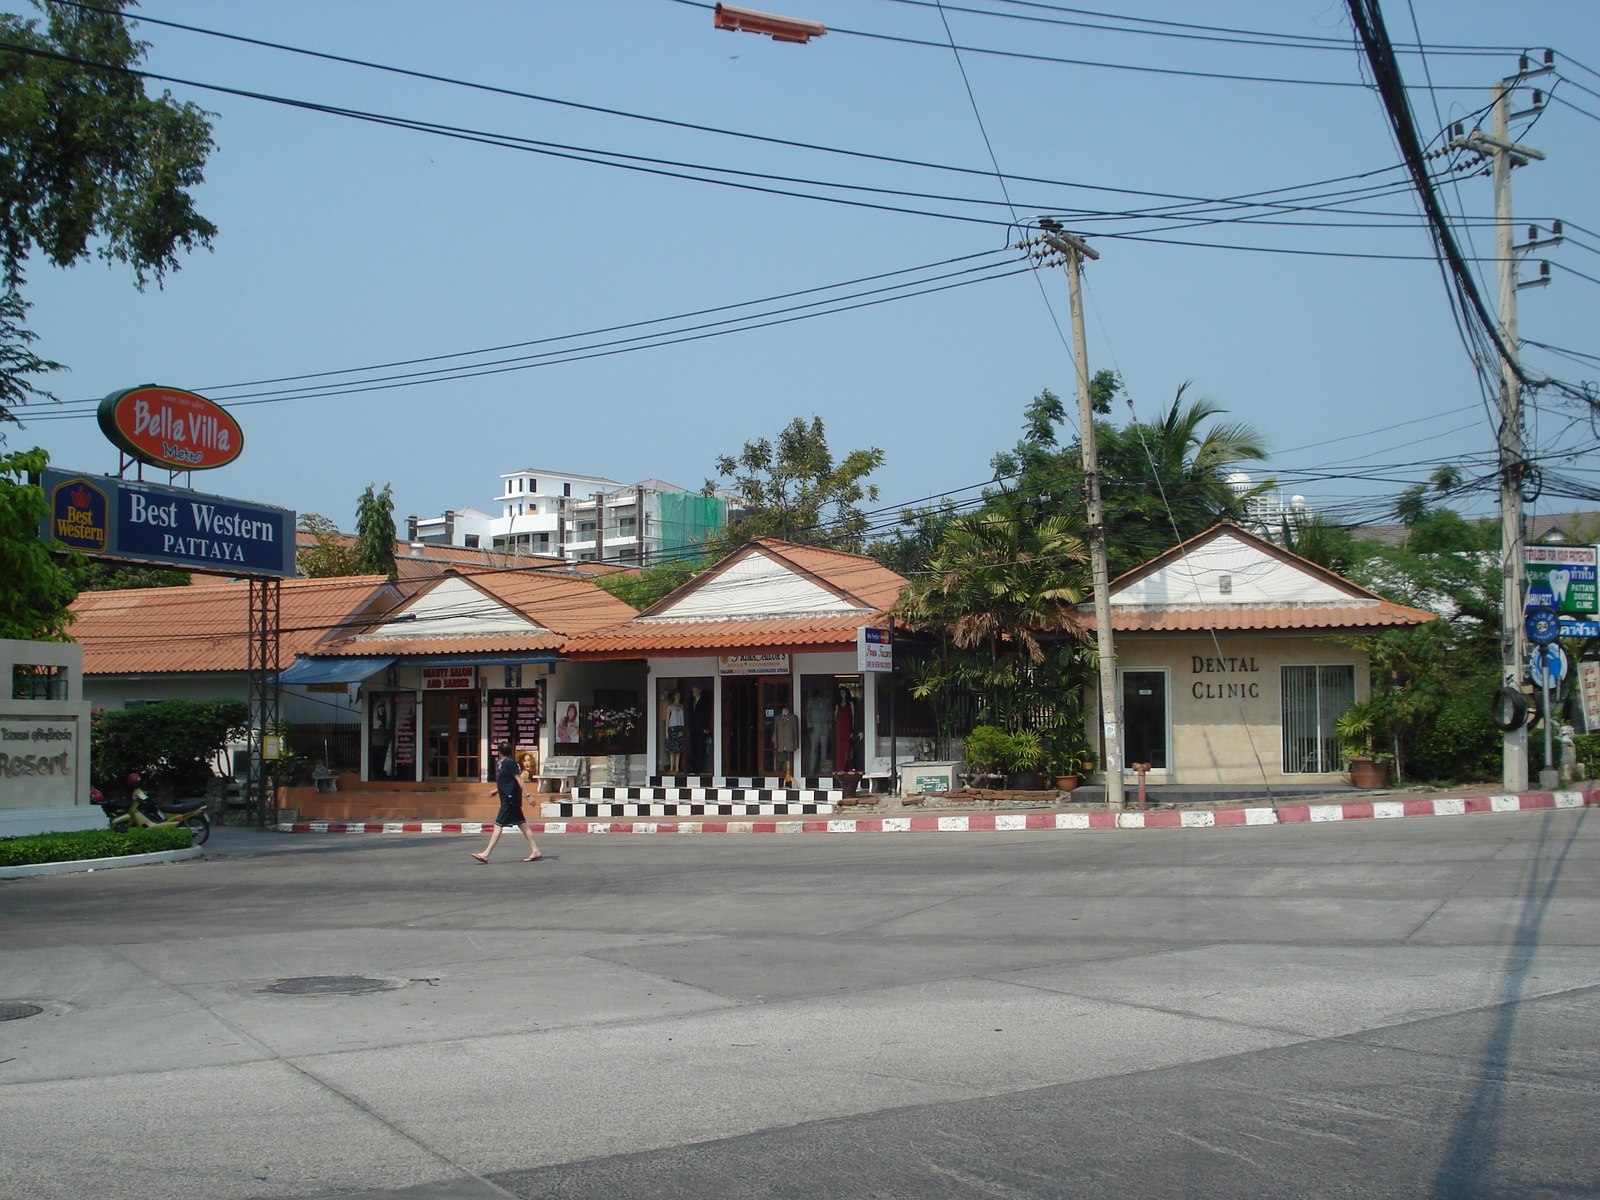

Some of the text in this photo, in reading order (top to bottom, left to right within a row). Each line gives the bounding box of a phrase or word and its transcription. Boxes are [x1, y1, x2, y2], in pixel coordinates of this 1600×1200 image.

[134, 399, 231, 451] Bella Villa
[162, 442, 203, 463] Metro
[67, 505, 94, 526] Best
[129, 493, 273, 542] Best Western
[57, 518, 104, 542] Western
[163, 534, 245, 562] PATTAYA
[1569, 550, 1594, 563] PROTECTION
[1571, 584, 1595, 593] PATTAYA
[1574, 593, 1594, 601] DENTAL
[1576, 601, 1593, 609] CLINIC
[423, 667, 473, 678] BEAUTY SALON
[1191, 655, 1260, 674] DENTAL
[427, 678, 470, 688] AND BARBER
[1192, 681, 1259, 699] CLINIC
[0, 748, 71, 778] Resort
